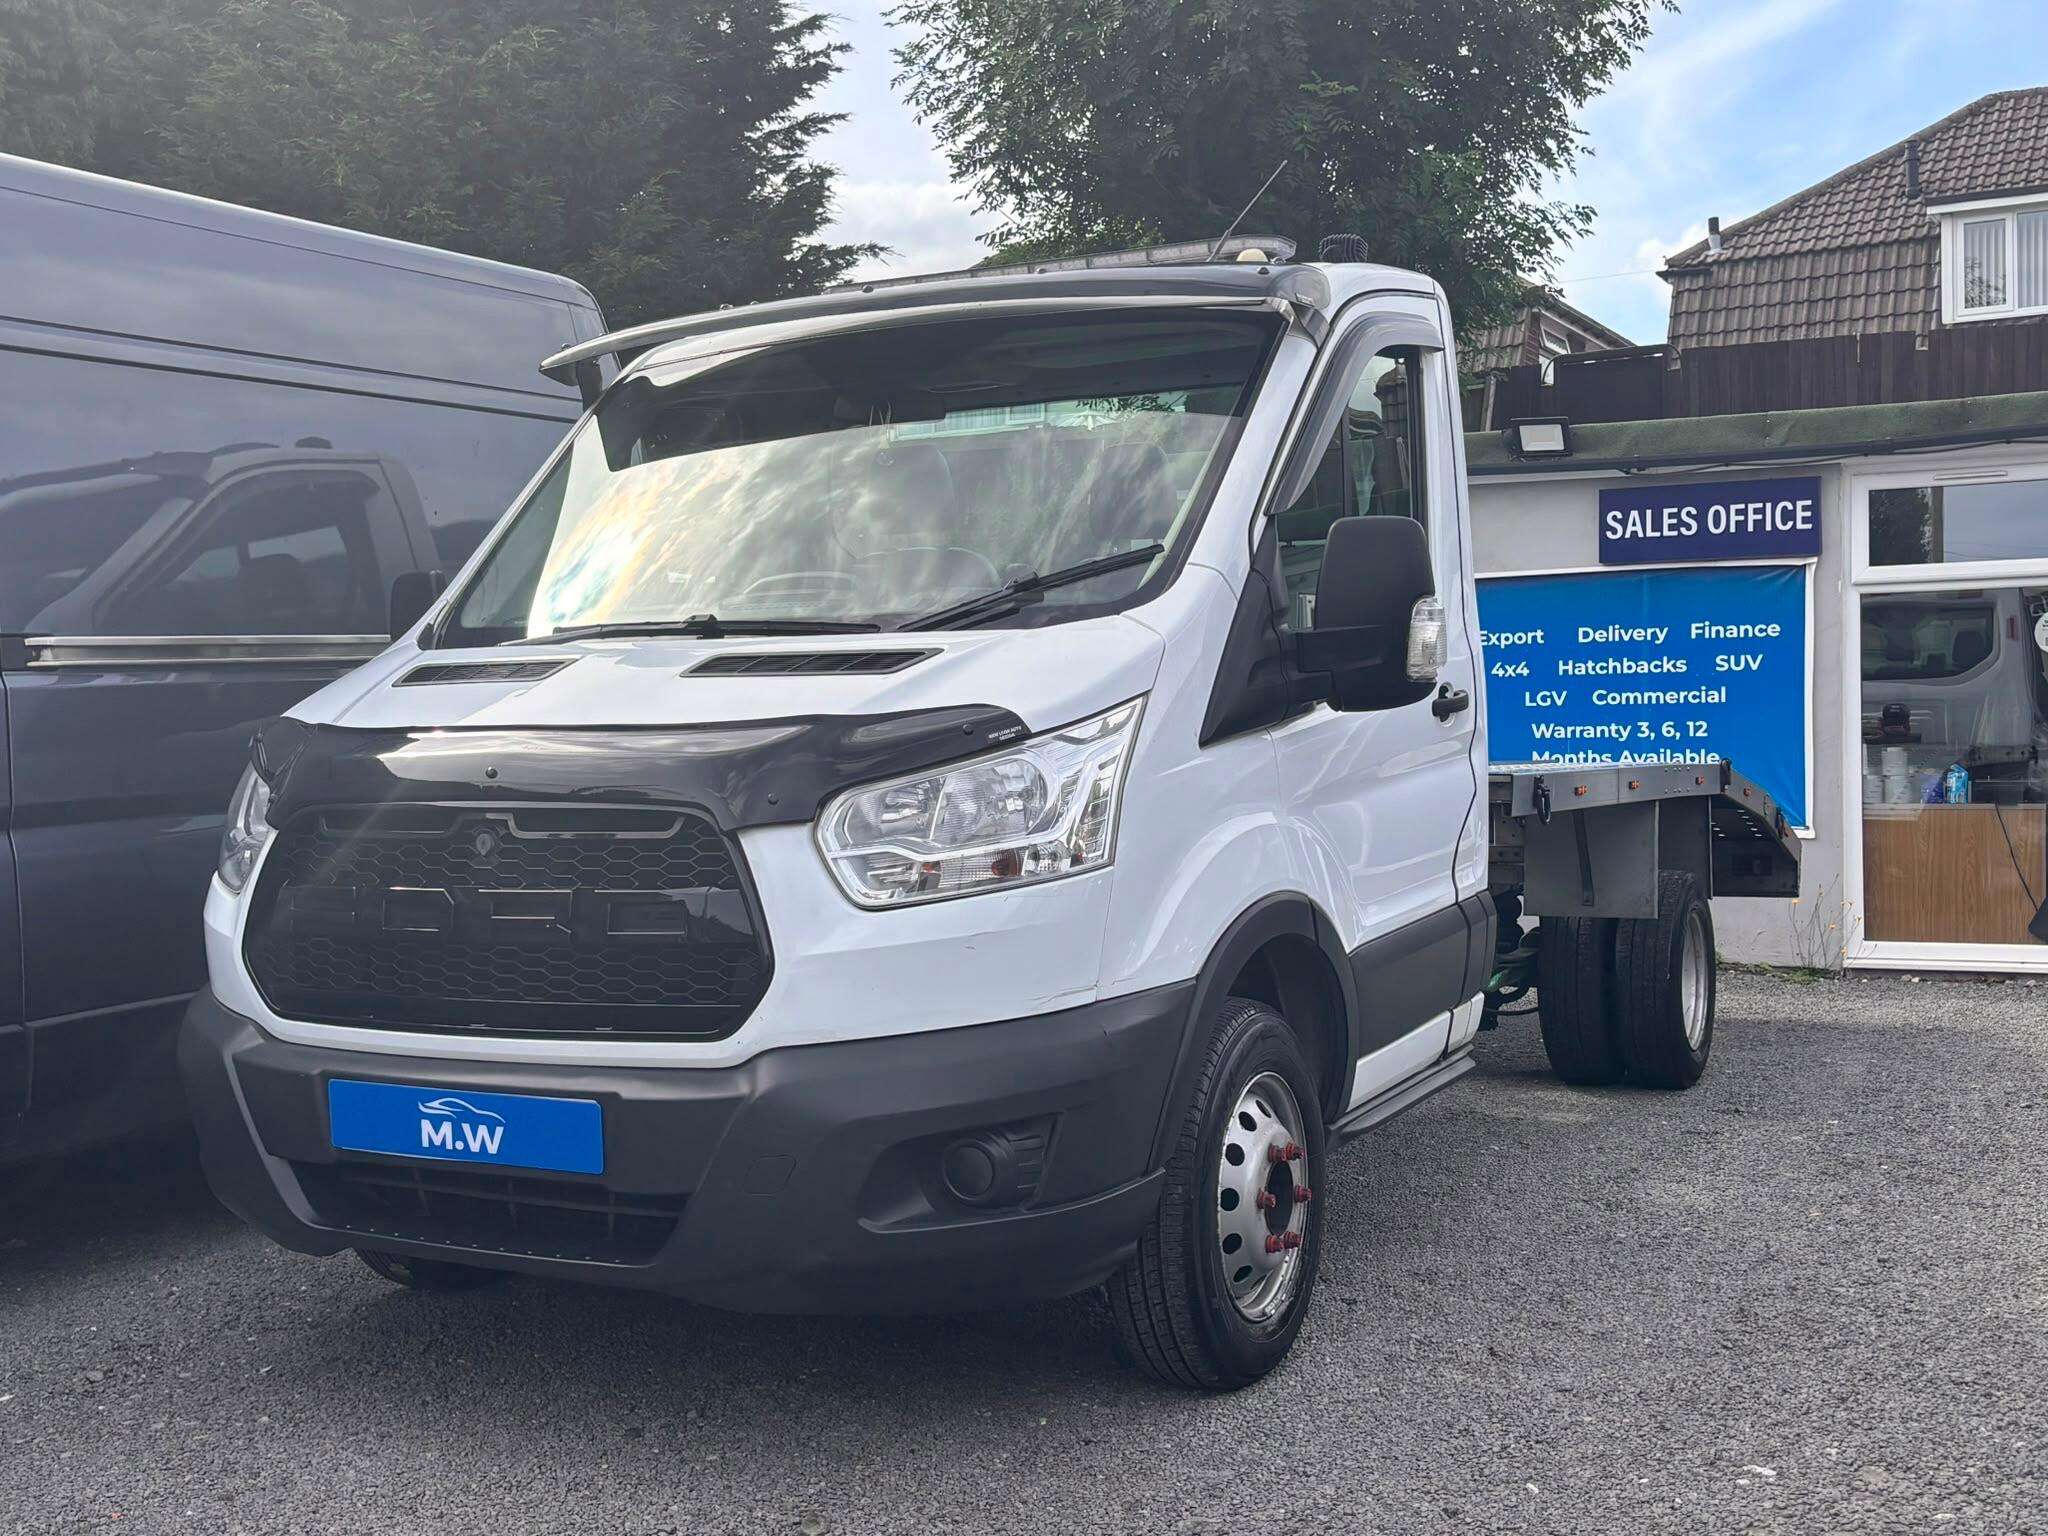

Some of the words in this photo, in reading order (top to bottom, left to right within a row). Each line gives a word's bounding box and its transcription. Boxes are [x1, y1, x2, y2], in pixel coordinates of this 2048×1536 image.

[1605, 506, 1698, 540] SALES
[1707, 499, 1813, 535] OFFICE
[1480, 628, 1545, 649] Export
[1577, 624, 1669, 646] Delivery
[1690, 621, 1781, 640] Finance
[1490, 661, 1530, 678] 4x4
[1557, 655, 1688, 676] Hatchbacks
[1714, 654, 1764, 672] SUV
[1524, 690, 1568, 707] LGV
[1591, 685, 1727, 706] Commercial
[1531, 723, 1632, 745] Warranty
[1637, 722, 1656, 741] 3,
[1661, 721, 1681, 740] 6,
[1685, 720, 1709, 737] 12
[1531, 750, 1612, 764] Months
[1620, 748, 1721, 765] Available
[420, 1119, 505, 1155] M.W
